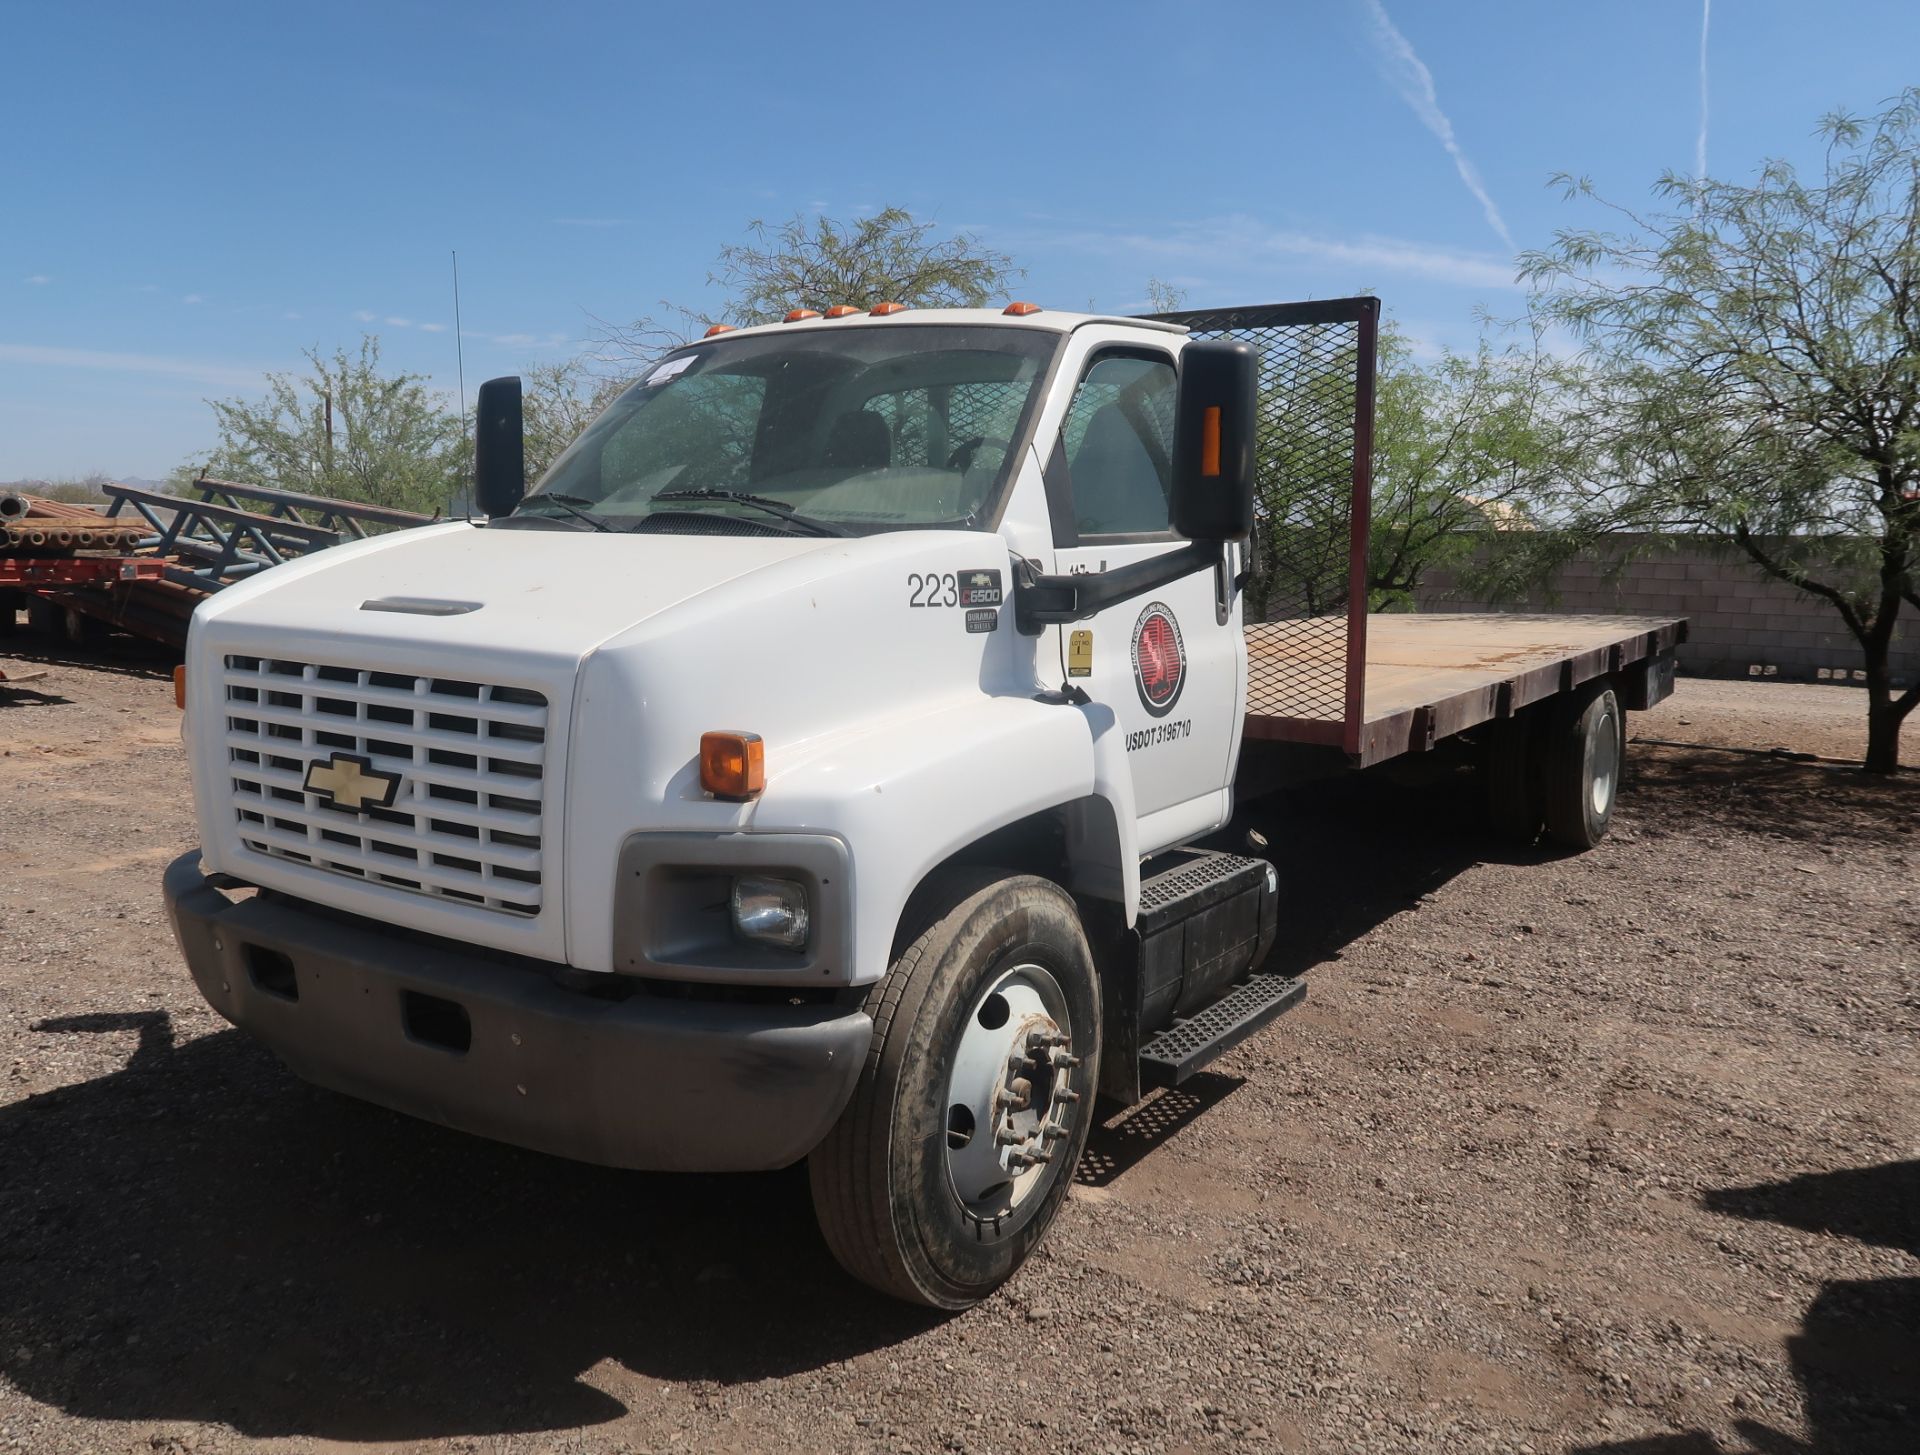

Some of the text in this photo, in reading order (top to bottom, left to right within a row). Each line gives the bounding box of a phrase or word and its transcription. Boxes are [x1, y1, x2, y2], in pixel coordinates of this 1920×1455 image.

[907, 573, 958, 608] 223
[962, 588, 1000, 604] C6500
[1125, 719, 1192, 752] USDOT 3196710
